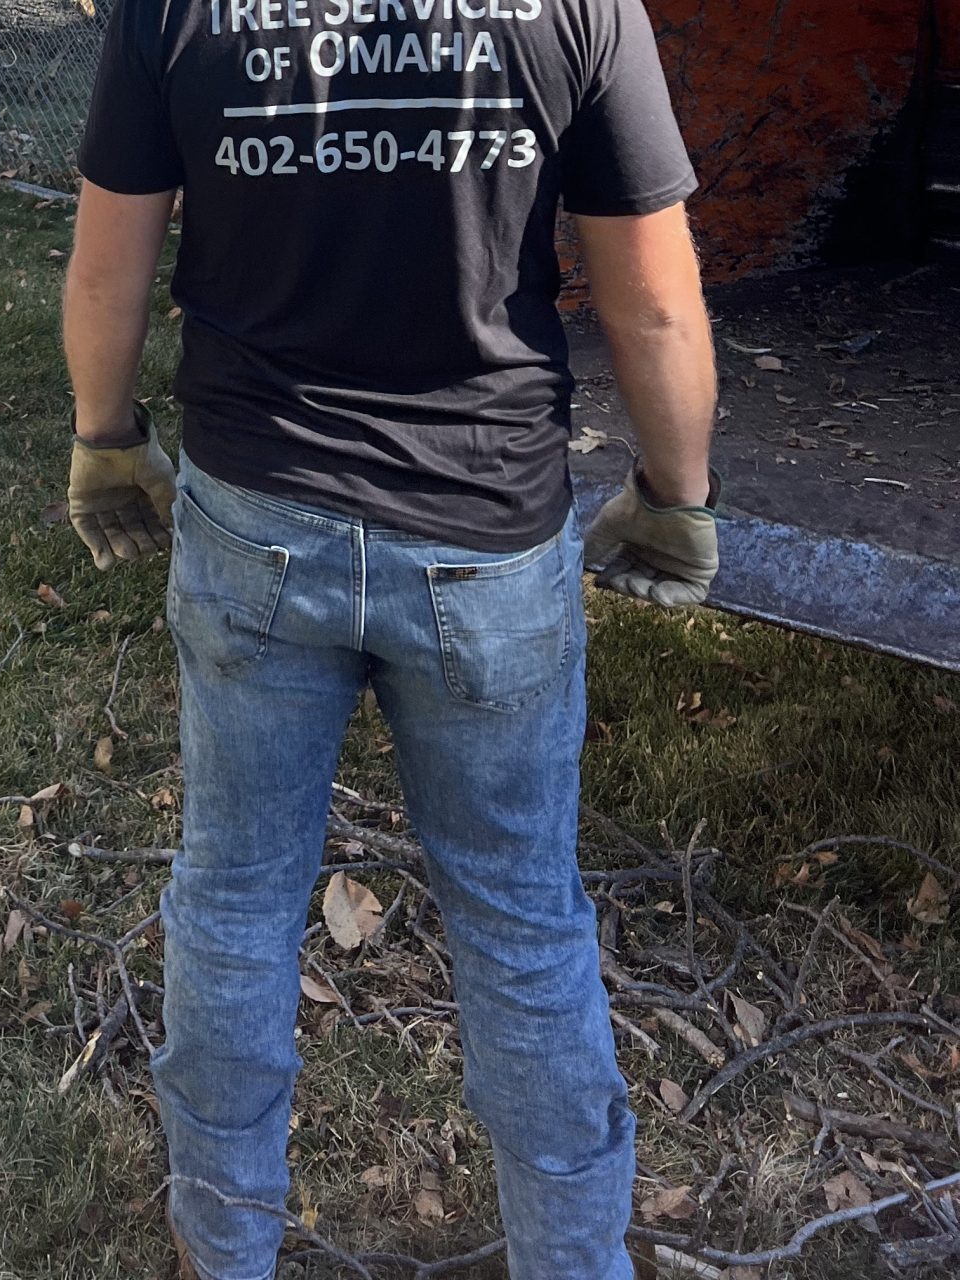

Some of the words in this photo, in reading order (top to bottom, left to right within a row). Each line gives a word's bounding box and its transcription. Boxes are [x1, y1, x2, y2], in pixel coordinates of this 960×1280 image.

[245, 46, 291, 82] OF
[310, 30, 502, 77] OMAHA
[214, 128, 537, 176] 402-650-4773
